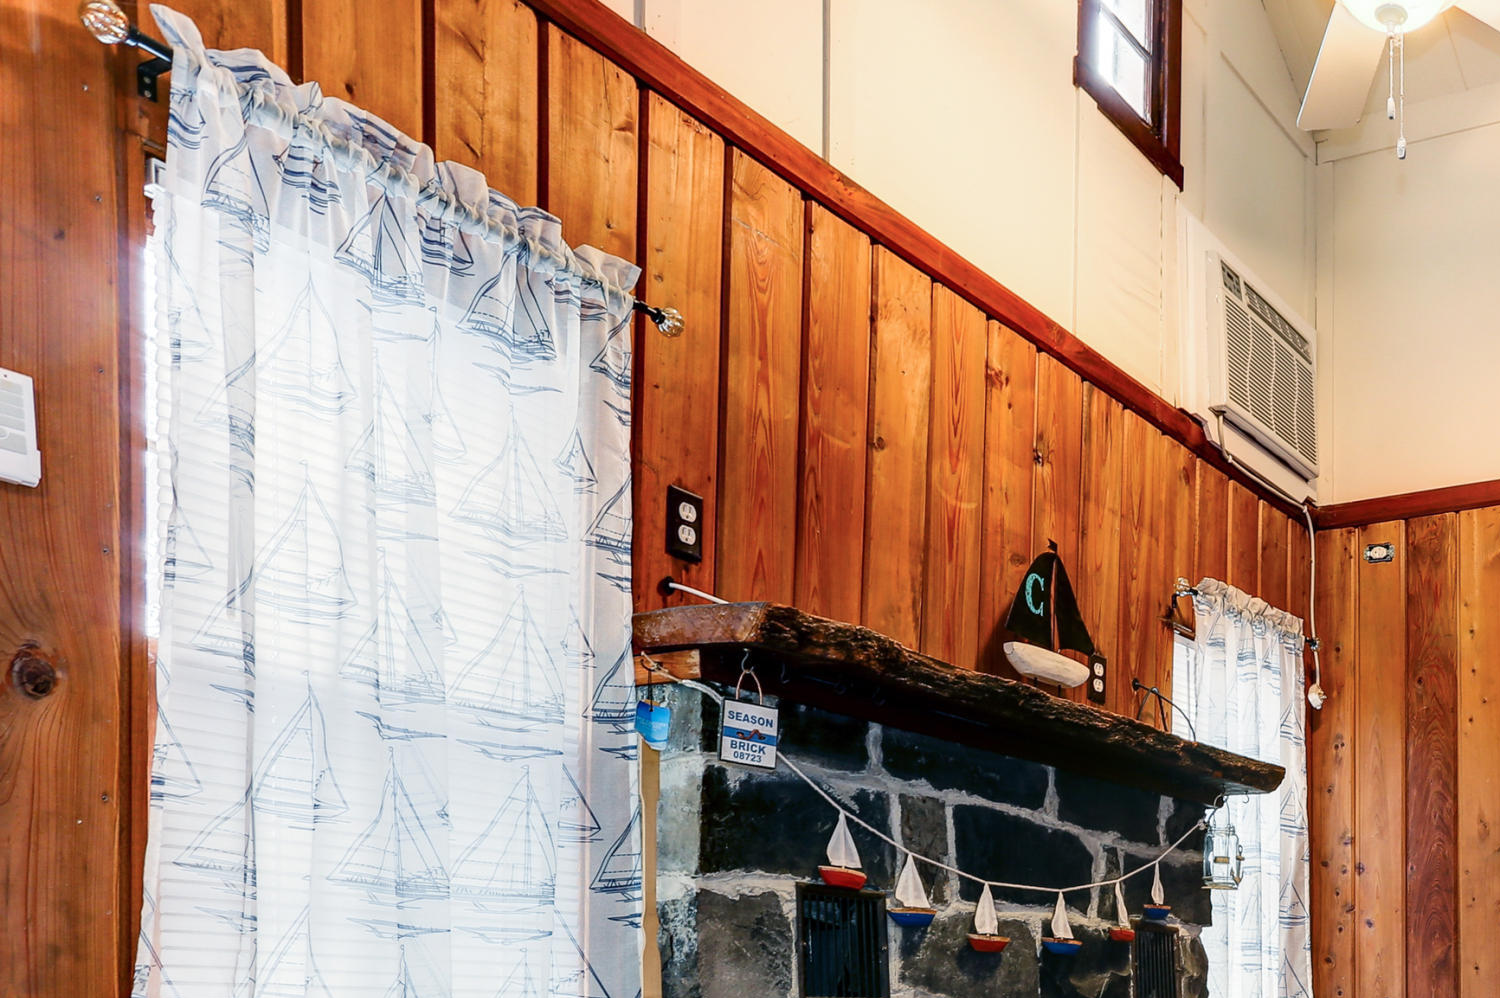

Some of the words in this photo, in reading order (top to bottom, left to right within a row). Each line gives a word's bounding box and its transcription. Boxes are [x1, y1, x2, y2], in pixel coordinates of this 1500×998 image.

[1025, 572, 1045, 617] C
[727, 710, 774, 728] SEASON
[730, 740, 767, 756] BRICK
[733, 750, 762, 763] 08723
